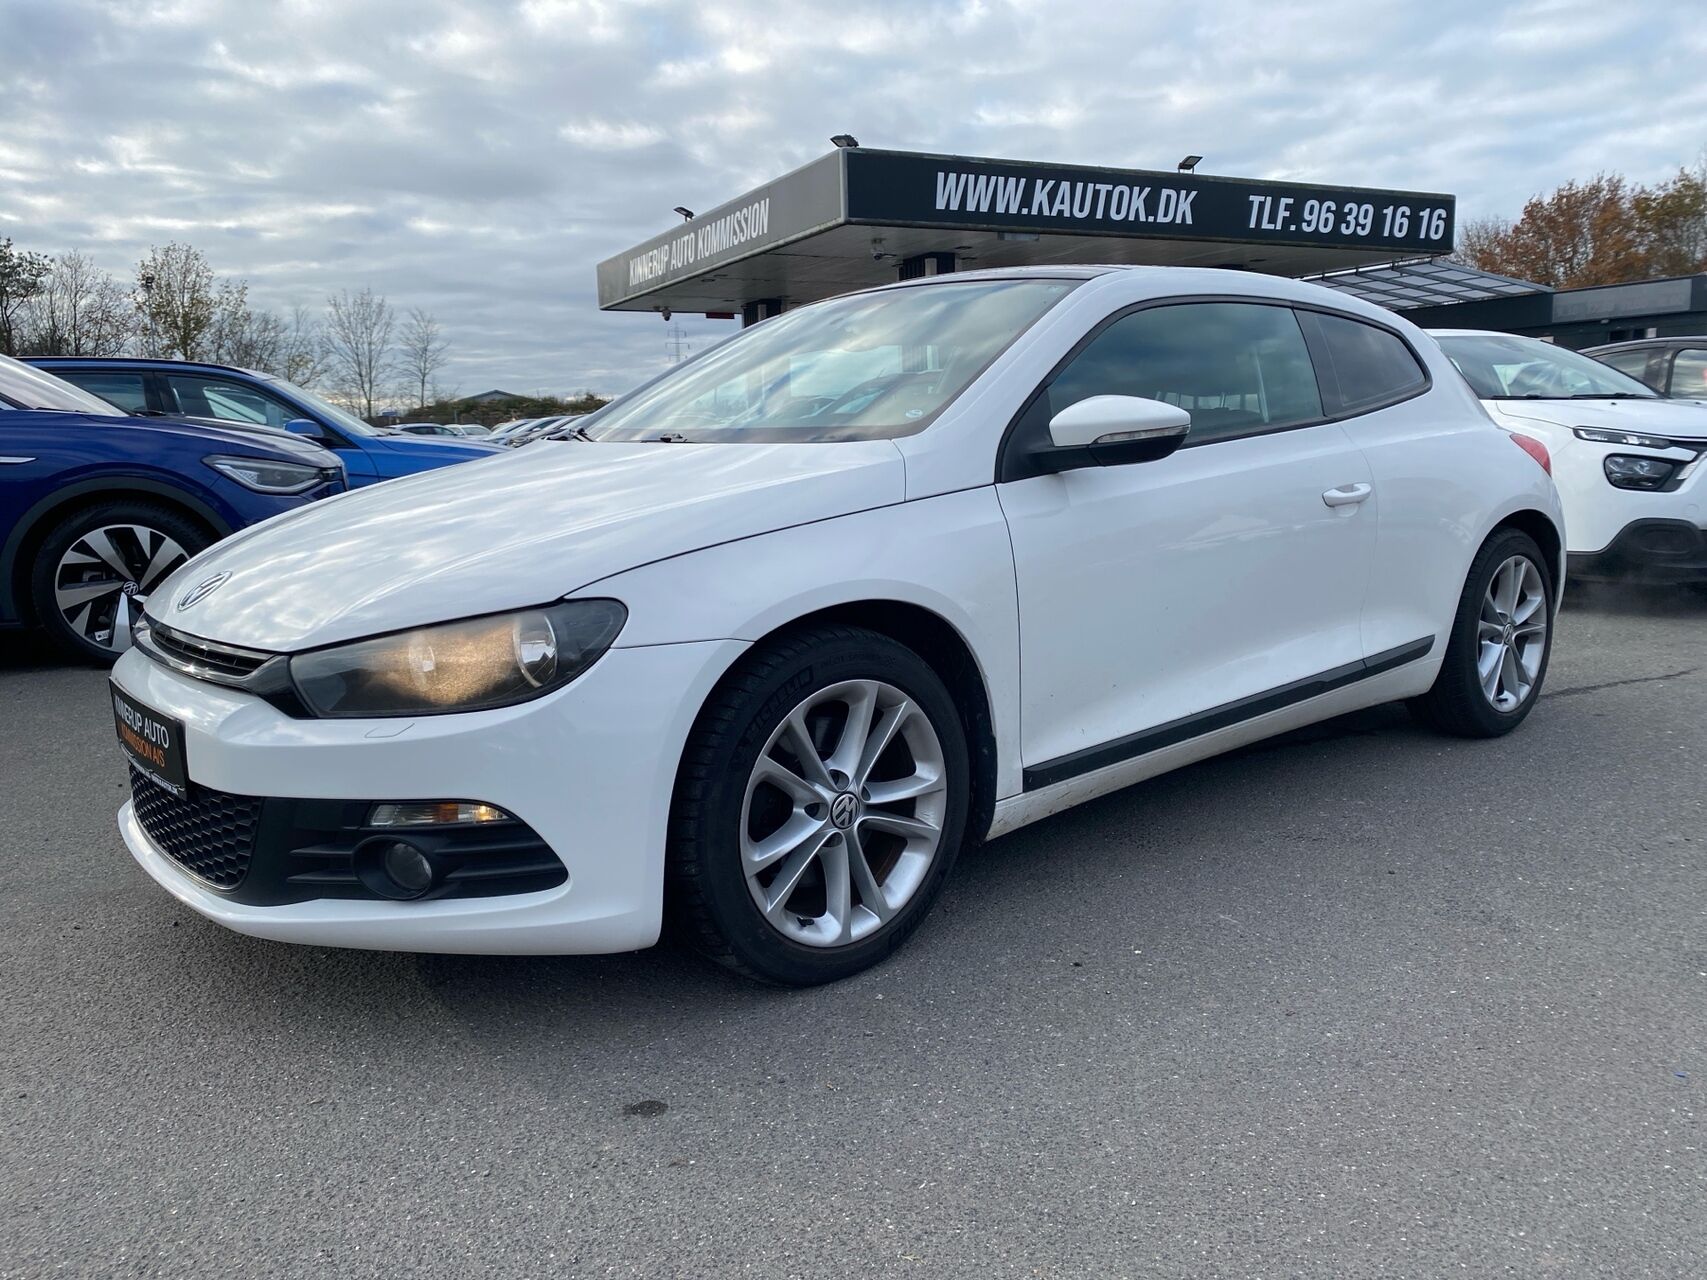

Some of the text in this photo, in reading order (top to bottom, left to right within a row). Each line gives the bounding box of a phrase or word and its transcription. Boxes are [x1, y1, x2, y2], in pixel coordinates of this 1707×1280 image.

[935, 171, 1447, 241] WWW.KAUTOK.DK TLF. 96 39 16 16
[629, 197, 770, 287] KINNERUP AUTO KOMMISSION
[144, 717, 169, 749] AUTO
